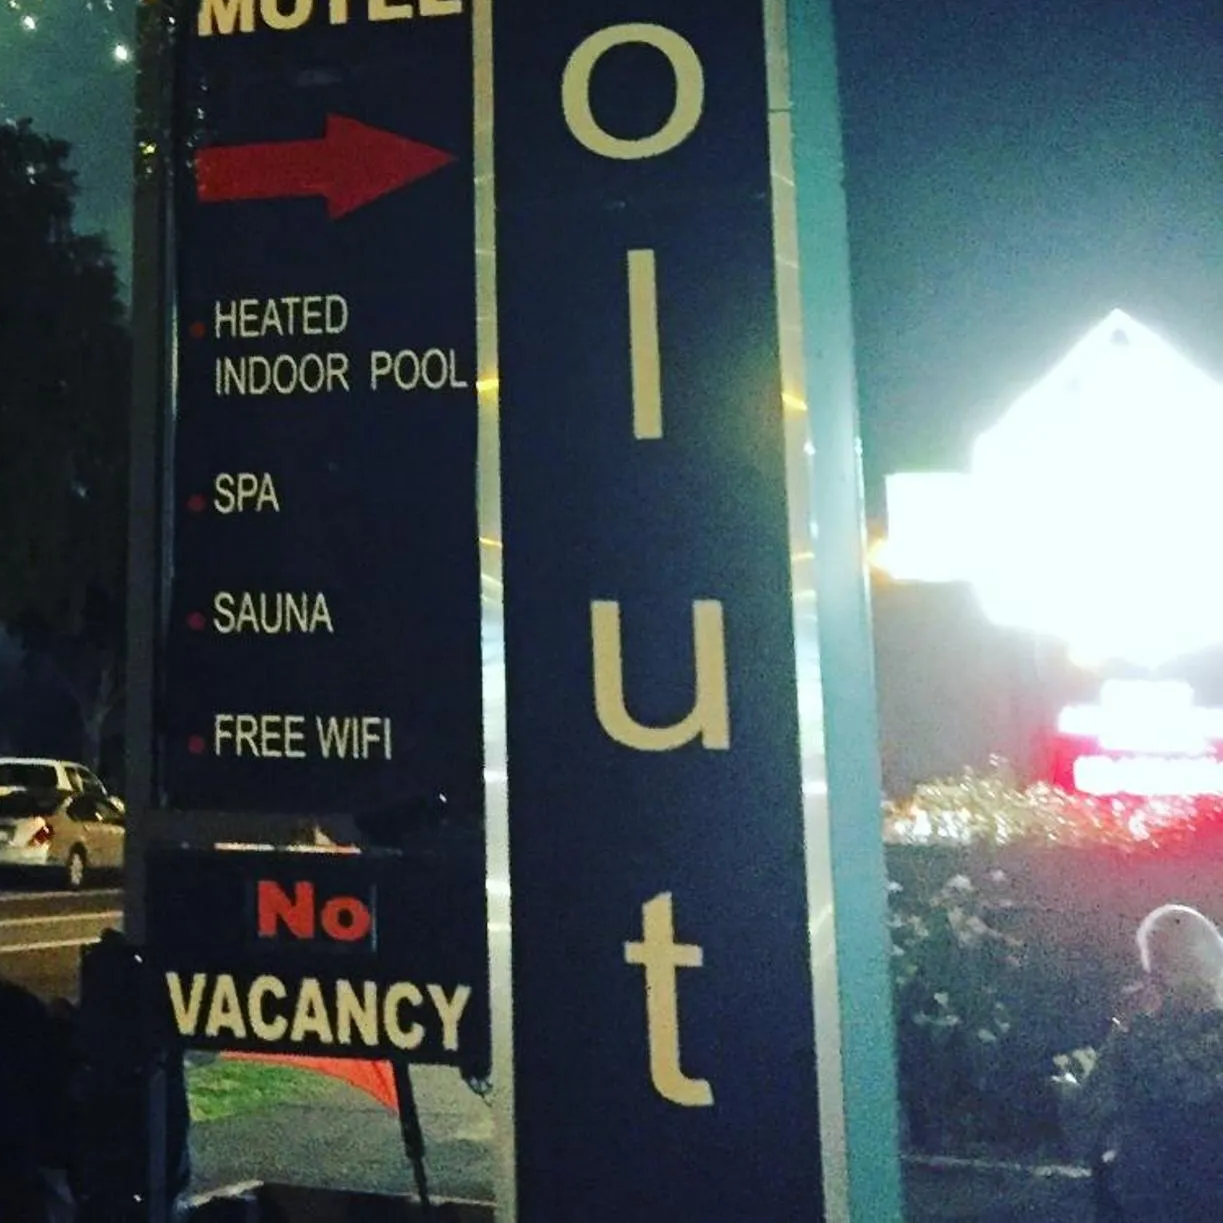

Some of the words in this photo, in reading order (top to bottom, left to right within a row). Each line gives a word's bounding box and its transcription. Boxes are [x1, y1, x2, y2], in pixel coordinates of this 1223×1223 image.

[214, 294, 349, 339] HEATED
[215, 352, 350, 396] INDOOR
[370, 348, 468, 391] POOL
[213, 473, 280, 515] SPA
[213, 592, 334, 634] SAUNA
[214, 714, 306, 758] FREE
[316, 716, 393, 761] WIFI
[256, 880, 372, 943] No
[164, 971, 472, 1052] VACANCY
